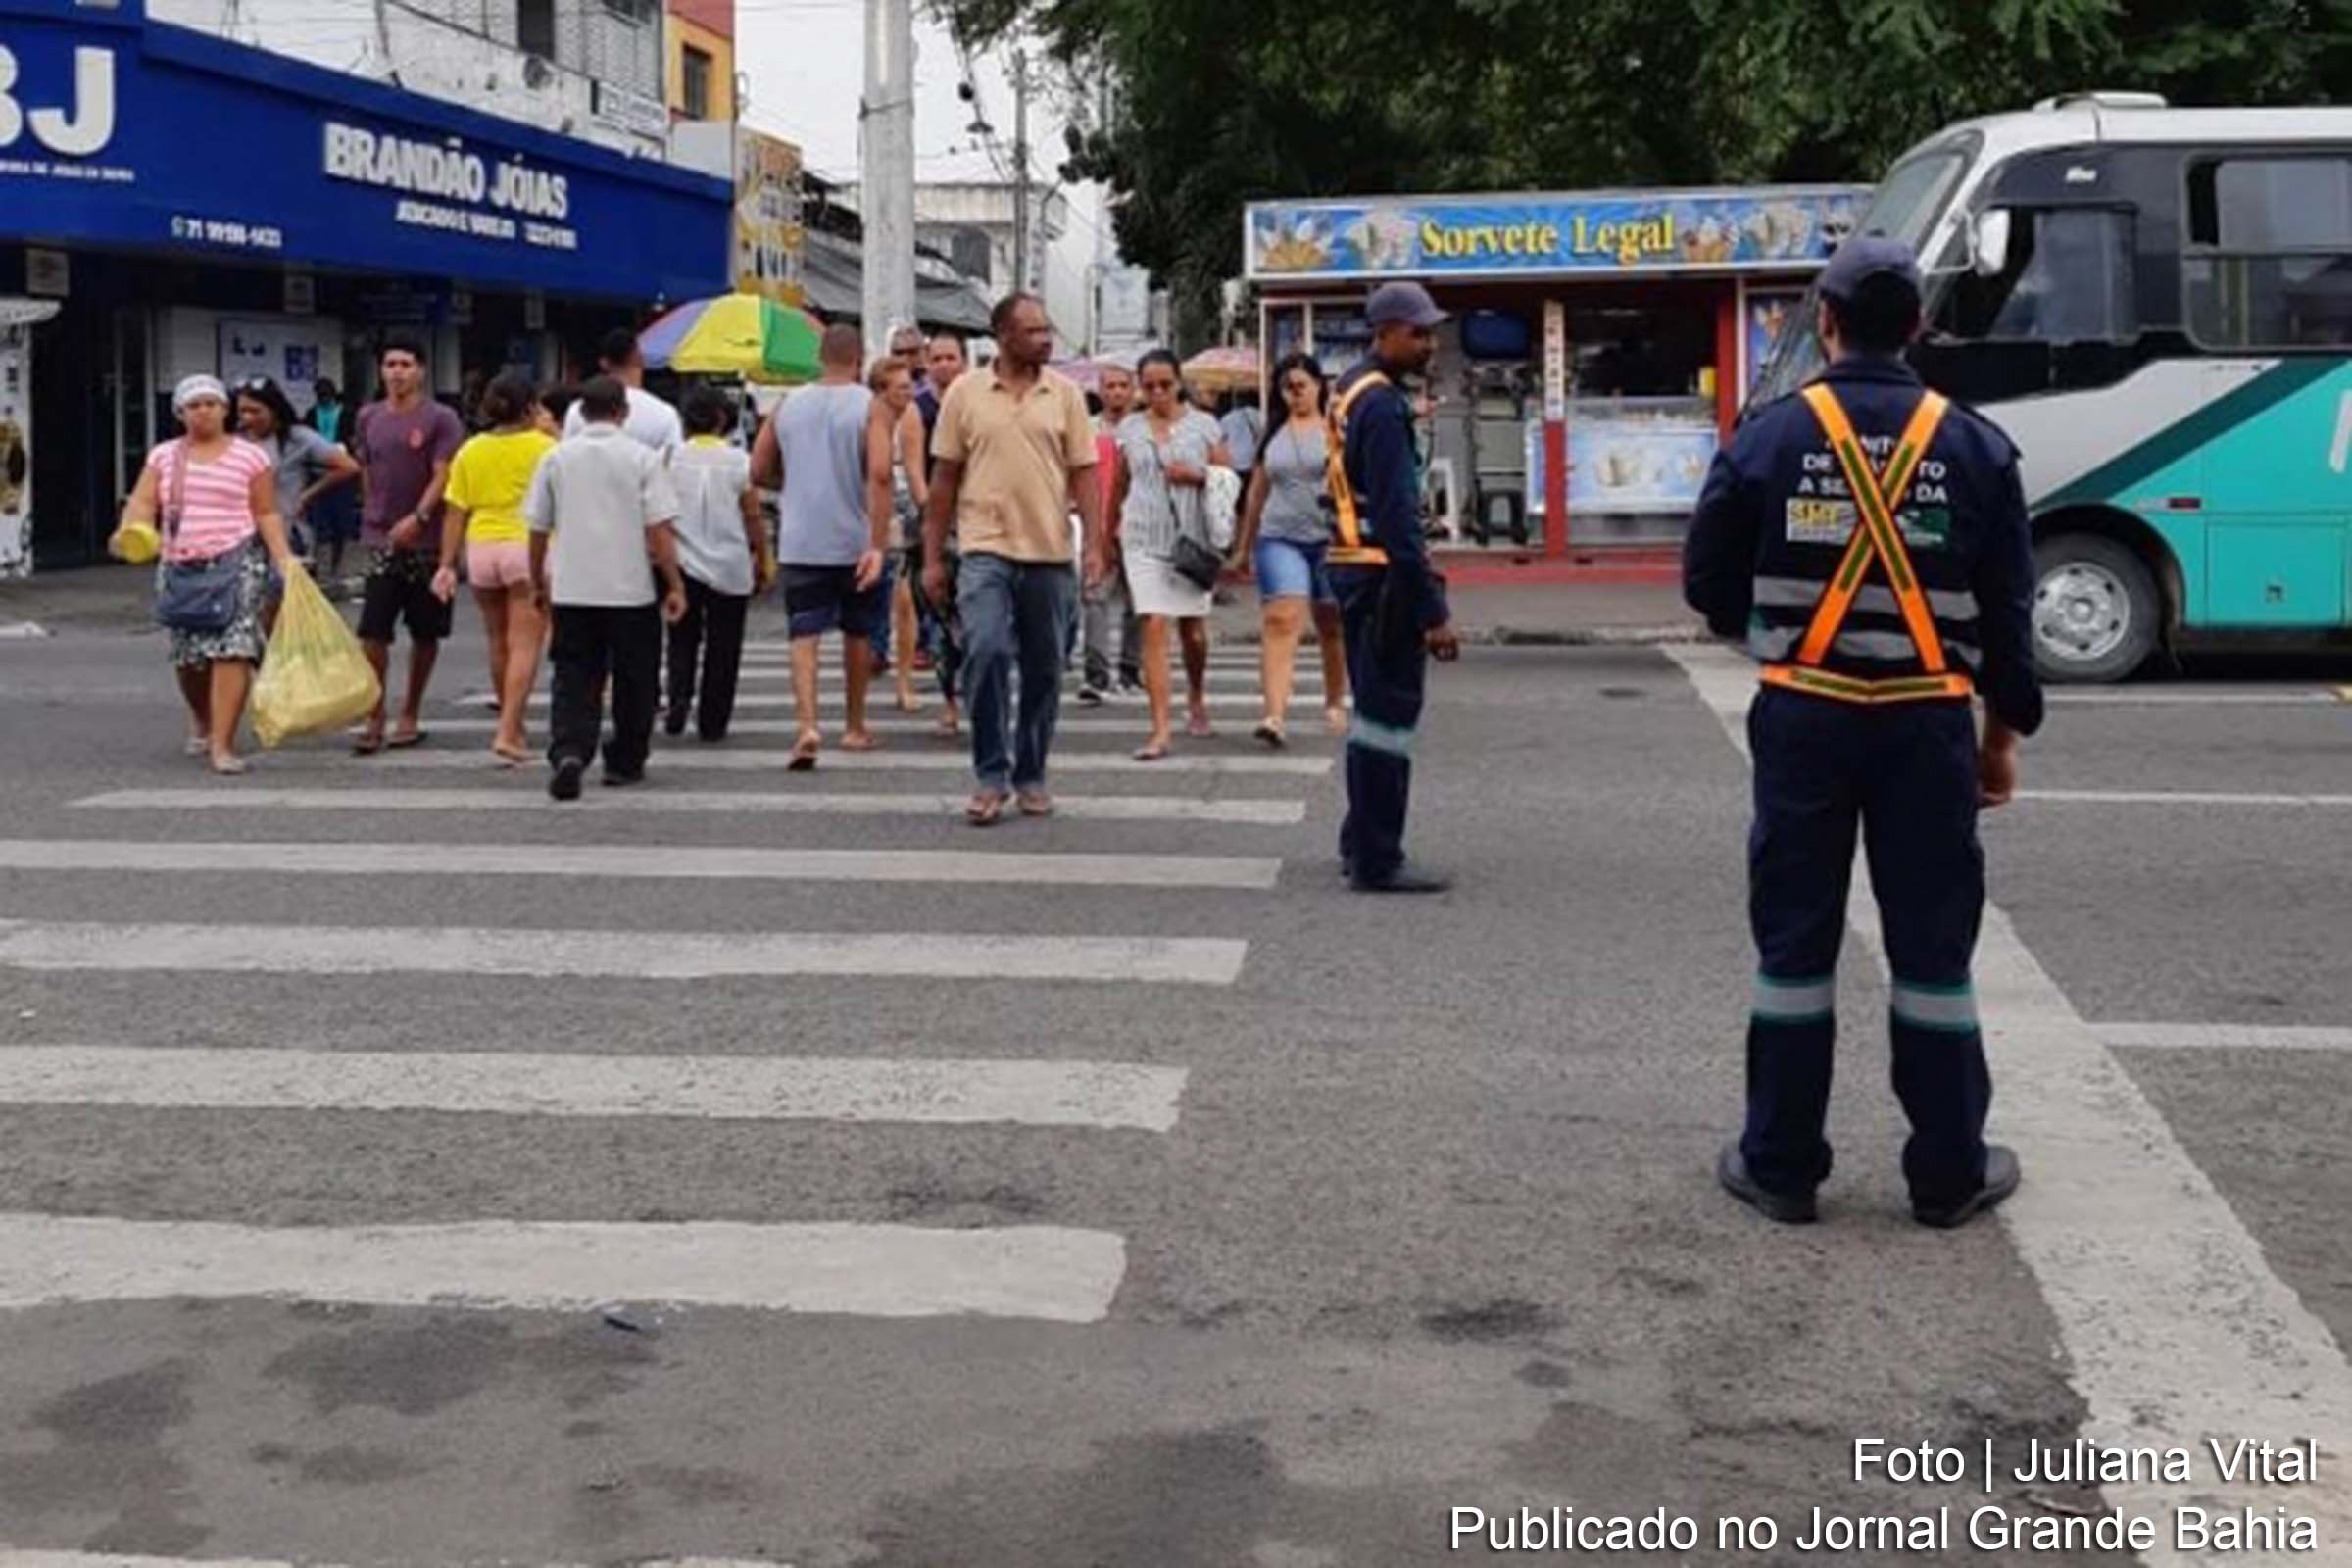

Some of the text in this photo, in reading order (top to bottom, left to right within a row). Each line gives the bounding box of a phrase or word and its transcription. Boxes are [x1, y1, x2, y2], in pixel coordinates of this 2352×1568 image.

[324, 122, 567, 219] BRANDÃO JÓIAS
[1421, 212, 1675, 266] Sorvete Legal
[1915, 483, 1948, 504] DA
